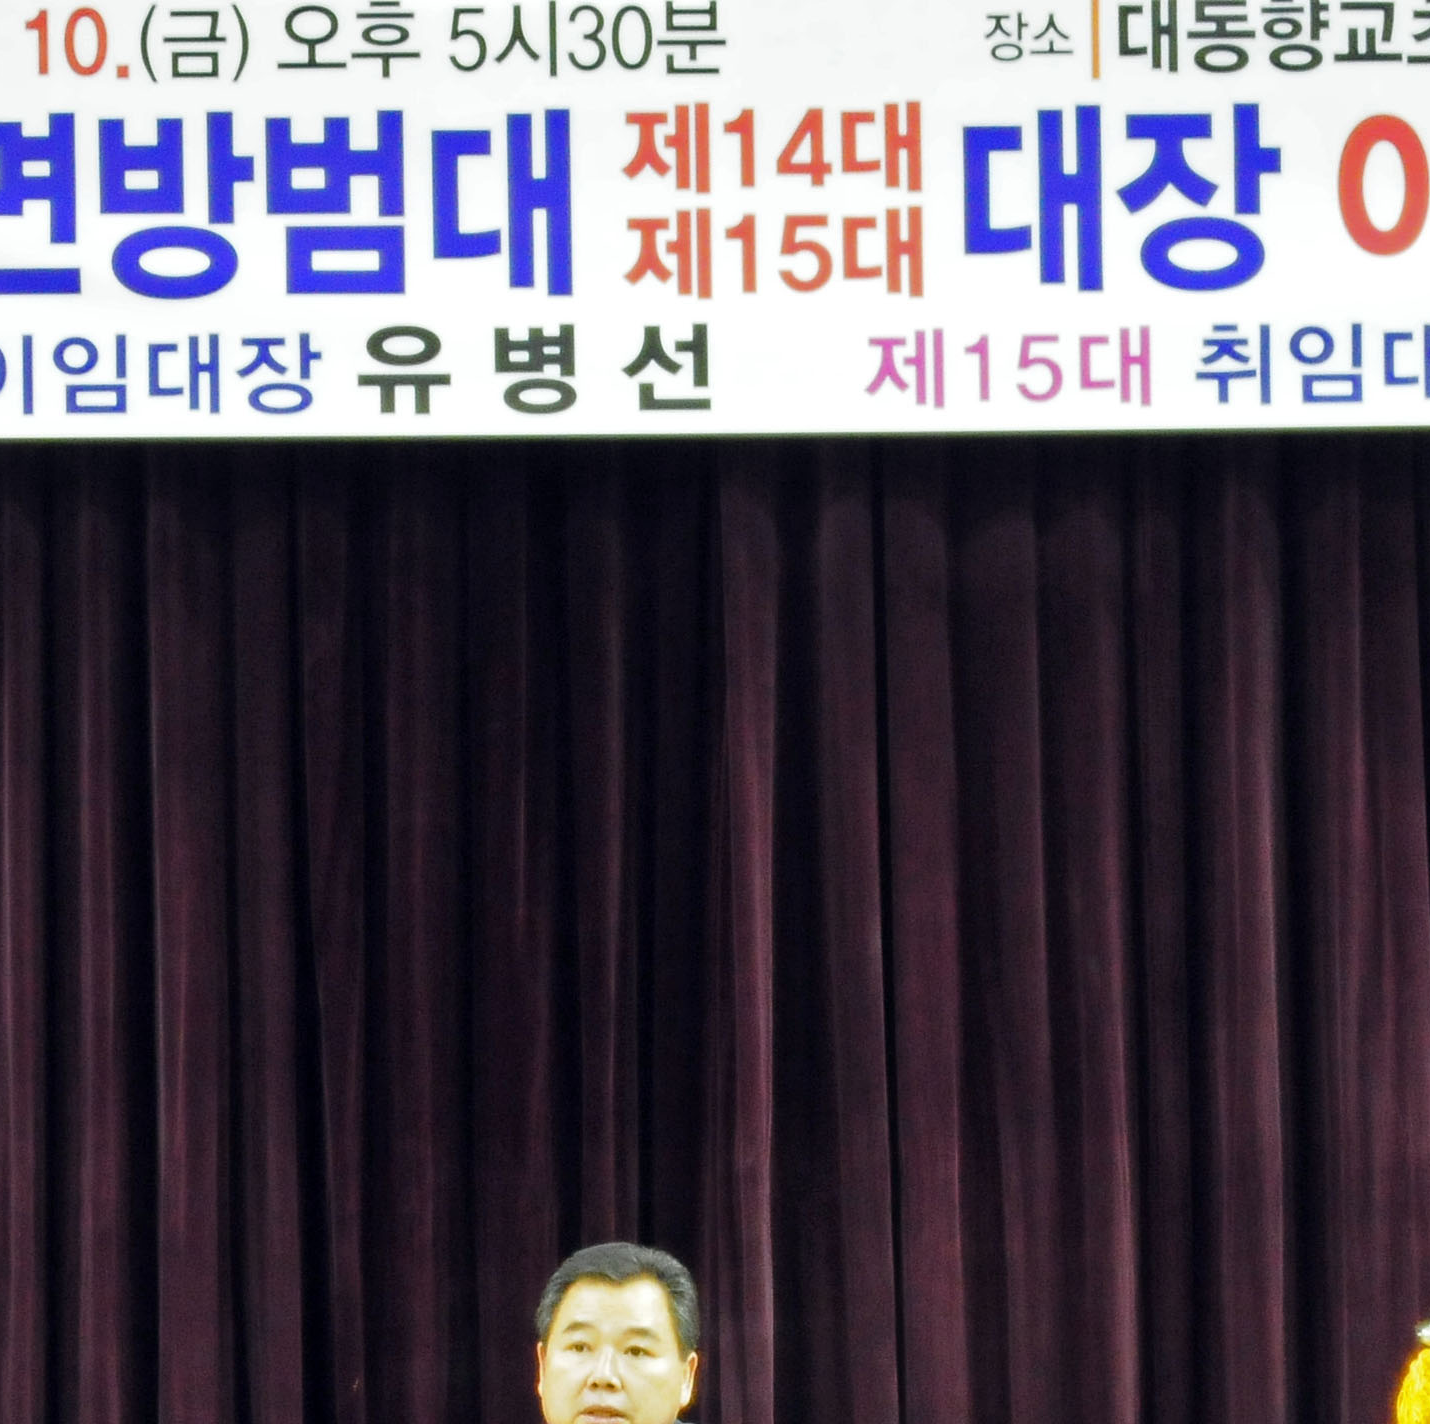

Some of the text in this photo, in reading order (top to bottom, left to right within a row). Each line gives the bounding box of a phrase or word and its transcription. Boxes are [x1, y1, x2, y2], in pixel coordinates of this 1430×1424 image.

[277, 1, 421, 78] 오후
[983, 12, 1074, 62] 장소
[621, 101, 925, 195] 제14대
[962, 102, 1282, 293] 대장
[623, 205, 925, 299] 제15대
[865, 325, 1154, 408] 제15대
